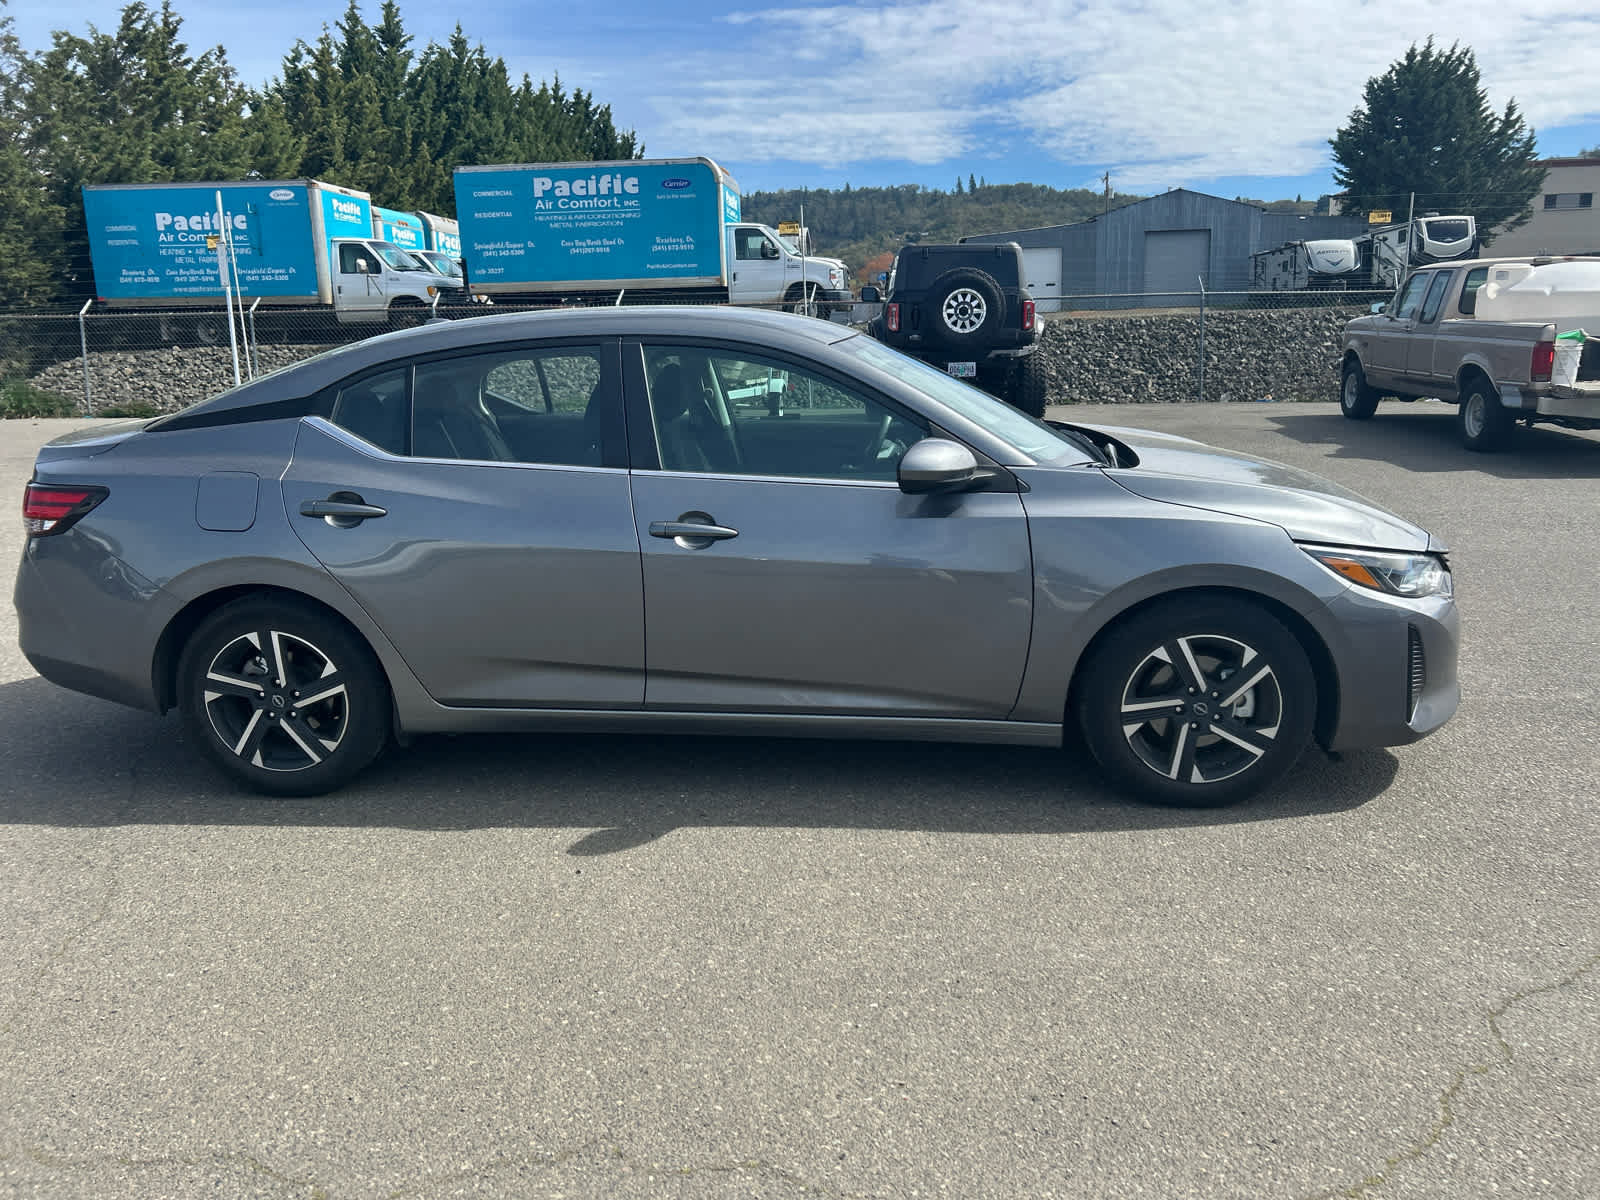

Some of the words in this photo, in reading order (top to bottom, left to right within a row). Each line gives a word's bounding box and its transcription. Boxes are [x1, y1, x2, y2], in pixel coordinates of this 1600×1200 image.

[533, 174, 639, 198] Pacific
[472, 189, 512, 197] COMMERCIAL
[331, 198, 361, 216] Pacific
[535, 199, 553, 210] Air
[575, 220, 624, 228] FABRICATION
[158, 232, 174, 242] Air
